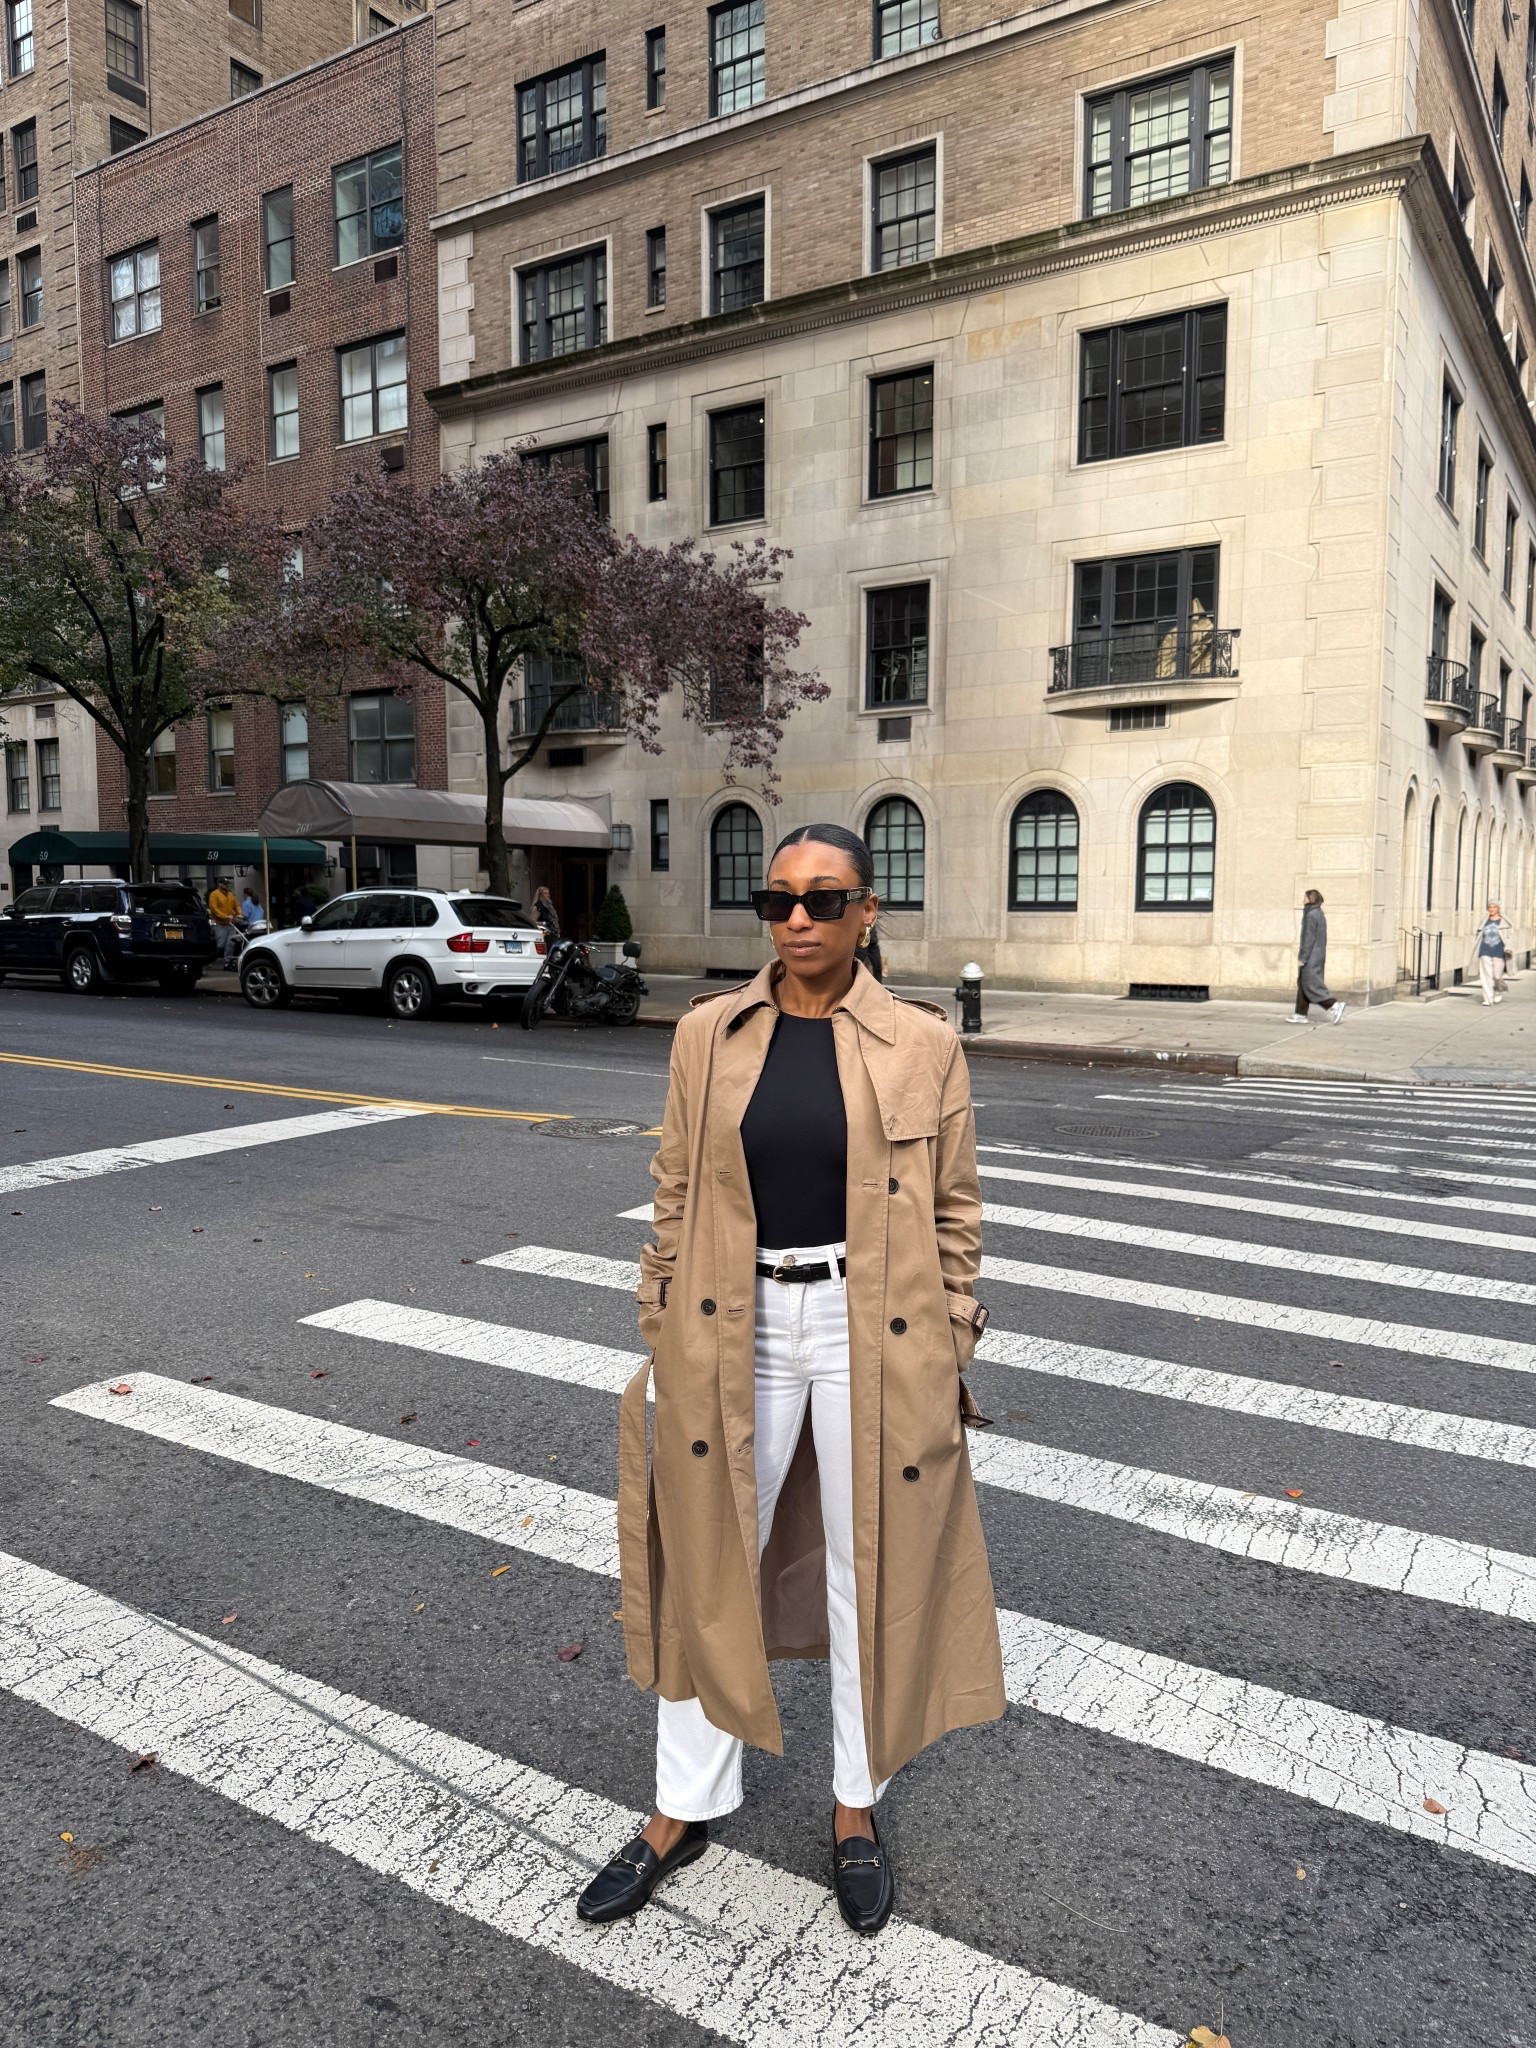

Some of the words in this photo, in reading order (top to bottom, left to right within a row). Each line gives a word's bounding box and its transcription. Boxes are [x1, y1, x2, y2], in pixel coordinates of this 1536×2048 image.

[296, 823, 313, 833] 760
[40, 851, 49, 861] 59
[207, 851, 219, 861] 59
